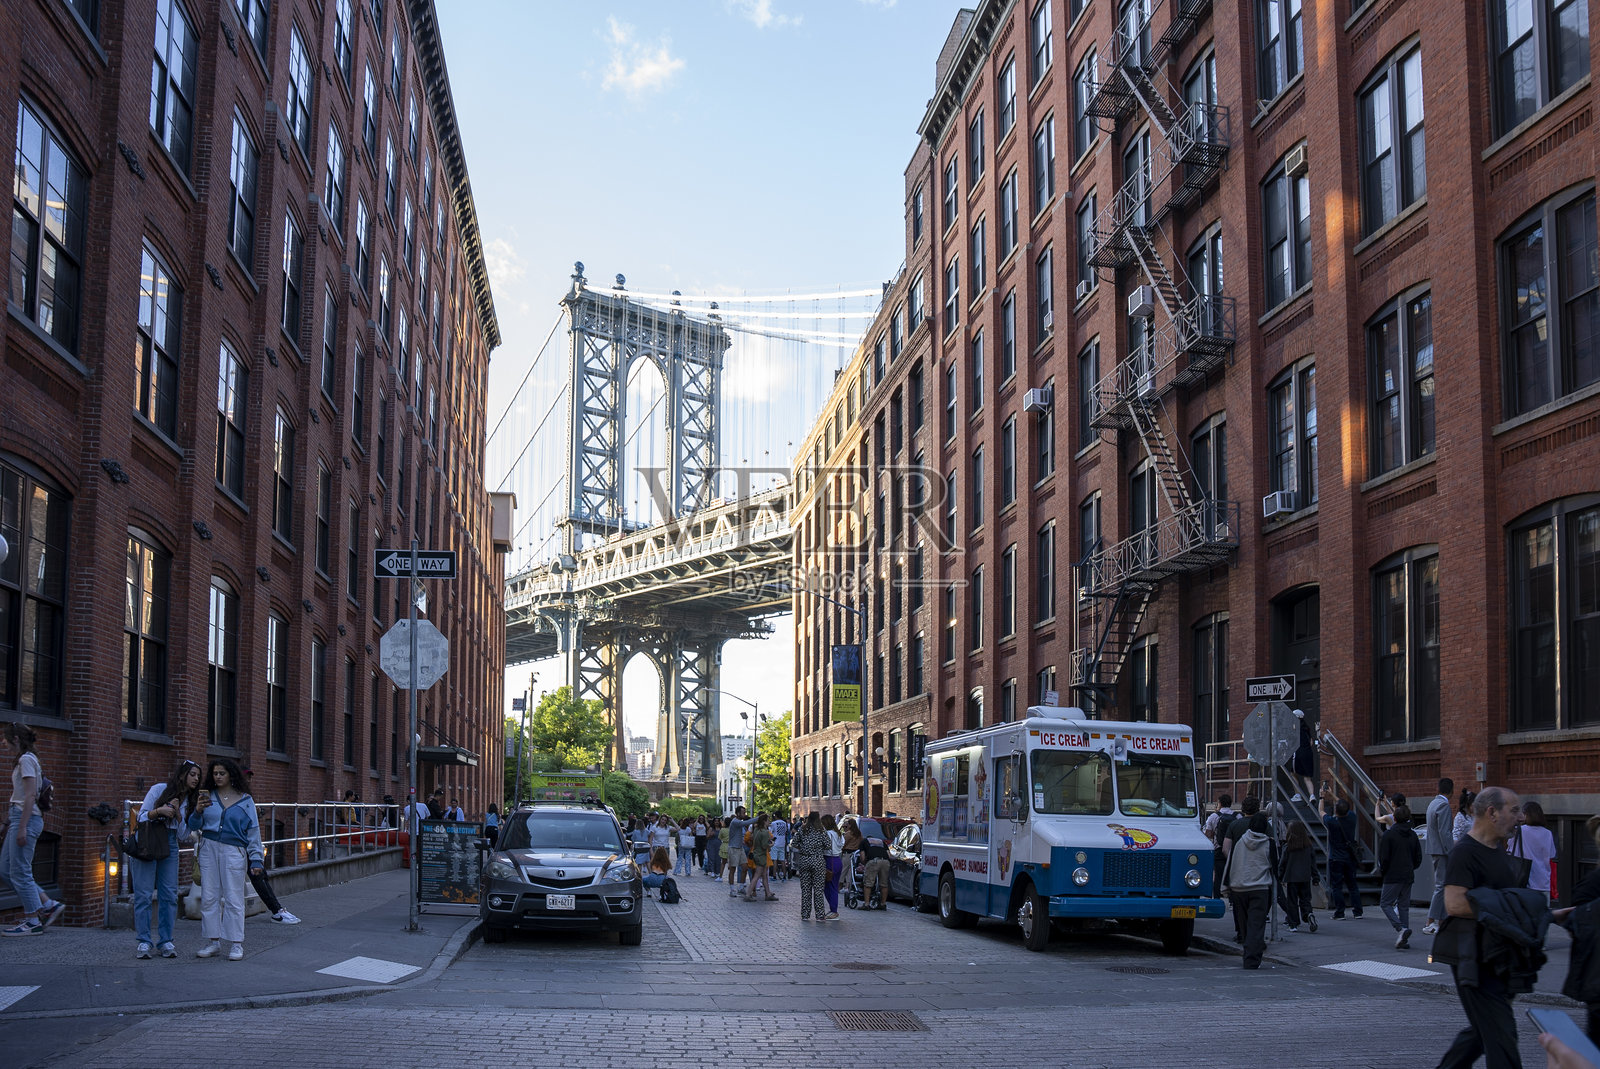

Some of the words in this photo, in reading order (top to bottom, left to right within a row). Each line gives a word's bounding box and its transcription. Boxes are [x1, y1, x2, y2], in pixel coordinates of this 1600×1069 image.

[387, 558, 410, 569] ONE
[420, 559, 445, 570] WAY
[1252, 686, 1266, 696] ONE
[1272, 684, 1287, 694] WAY
[1040, 732, 1056, 746] ICE
[1058, 733, 1091, 748] CREAM
[1132, 736, 1148, 750] ICE
[1149, 737, 1180, 751] CREAM
[924, 855, 938, 867] SHAKES
[953, 857, 967, 872] CONES
